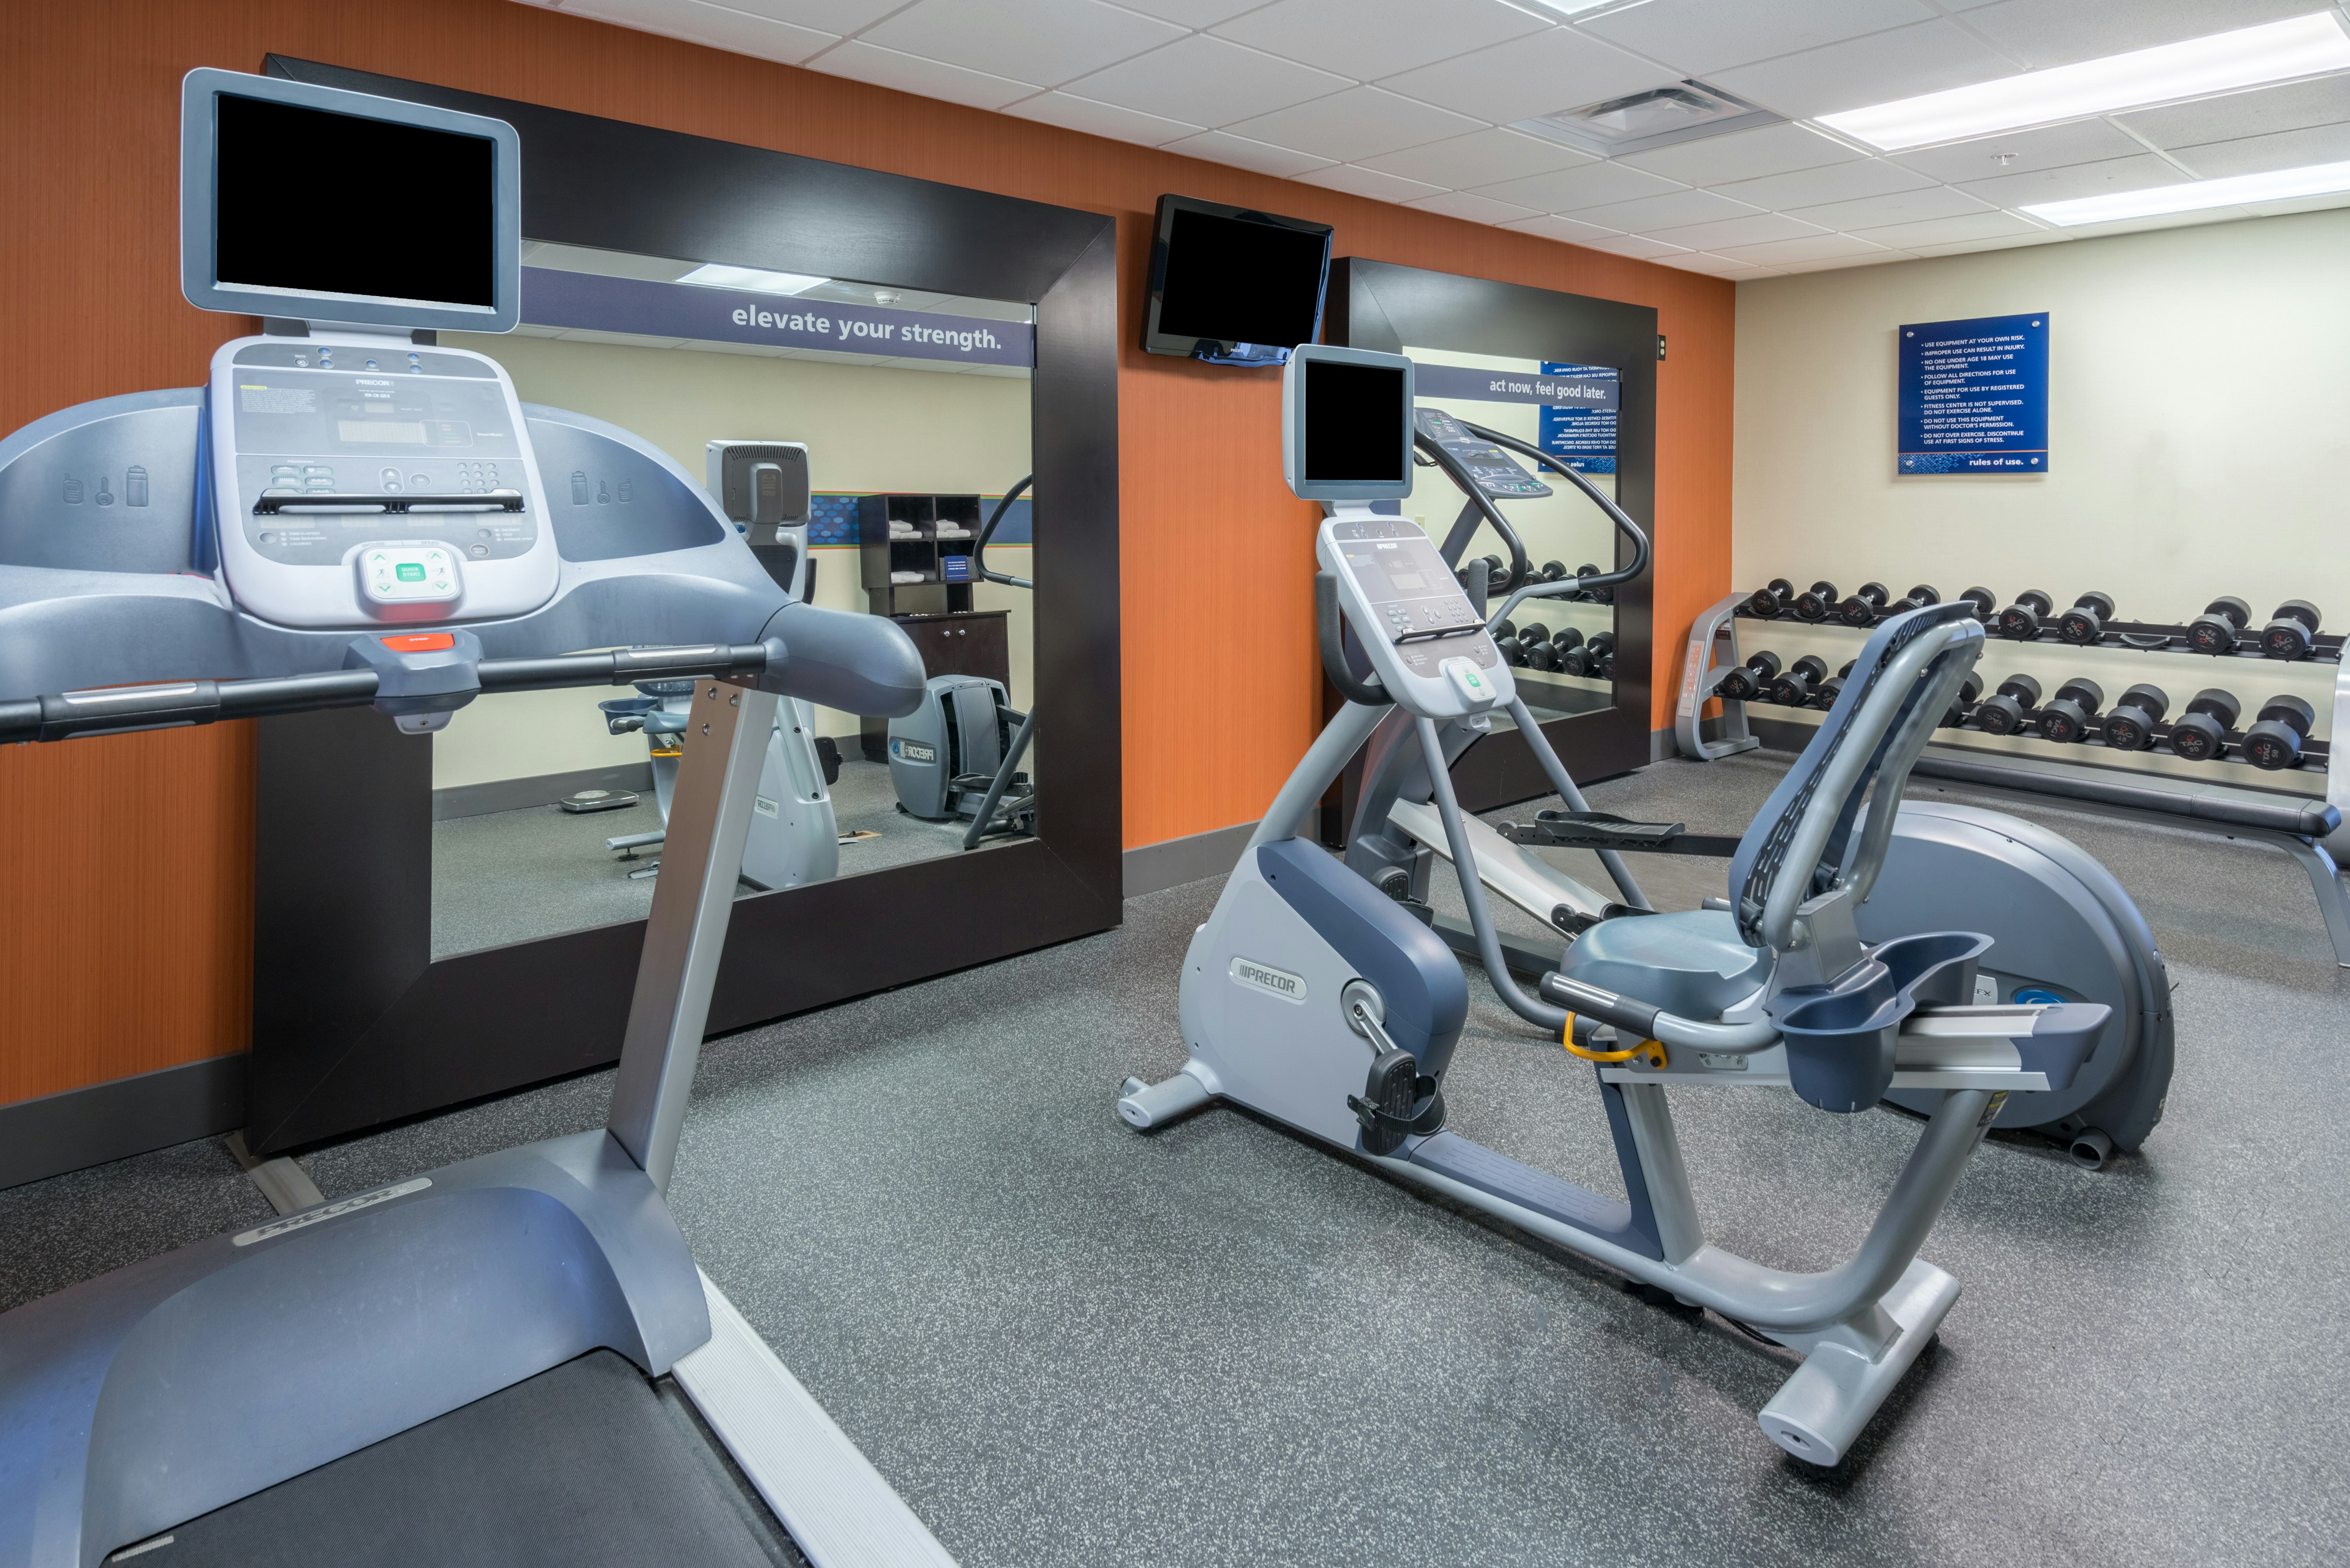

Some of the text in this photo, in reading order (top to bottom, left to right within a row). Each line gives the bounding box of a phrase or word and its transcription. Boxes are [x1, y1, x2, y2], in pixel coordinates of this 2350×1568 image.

[732, 305, 1001, 352] elevate your strength.
[1490, 380, 1605, 399] act now, feel good later.
[1805, 599, 1814, 613] TAG
[1849, 607, 1861, 617] TAG
[2007, 619, 2024, 628] TAG
[2071, 620, 2083, 635] TAG
[2198, 630, 2215, 645] TAG
[2272, 637, 2293, 648] TAG
[1684, 644, 1702, 693] PRECOR
[1733, 680, 1741, 693] TAG
[2051, 719, 2062, 735] TAG
[2111, 729, 2134, 739] TAG
[2263, 743, 2271, 761] TAG
[2272, 750, 2279, 758] 50
[1247, 967, 1295, 994] PRECOR
[256, 1190, 396, 1238] PRECOR
